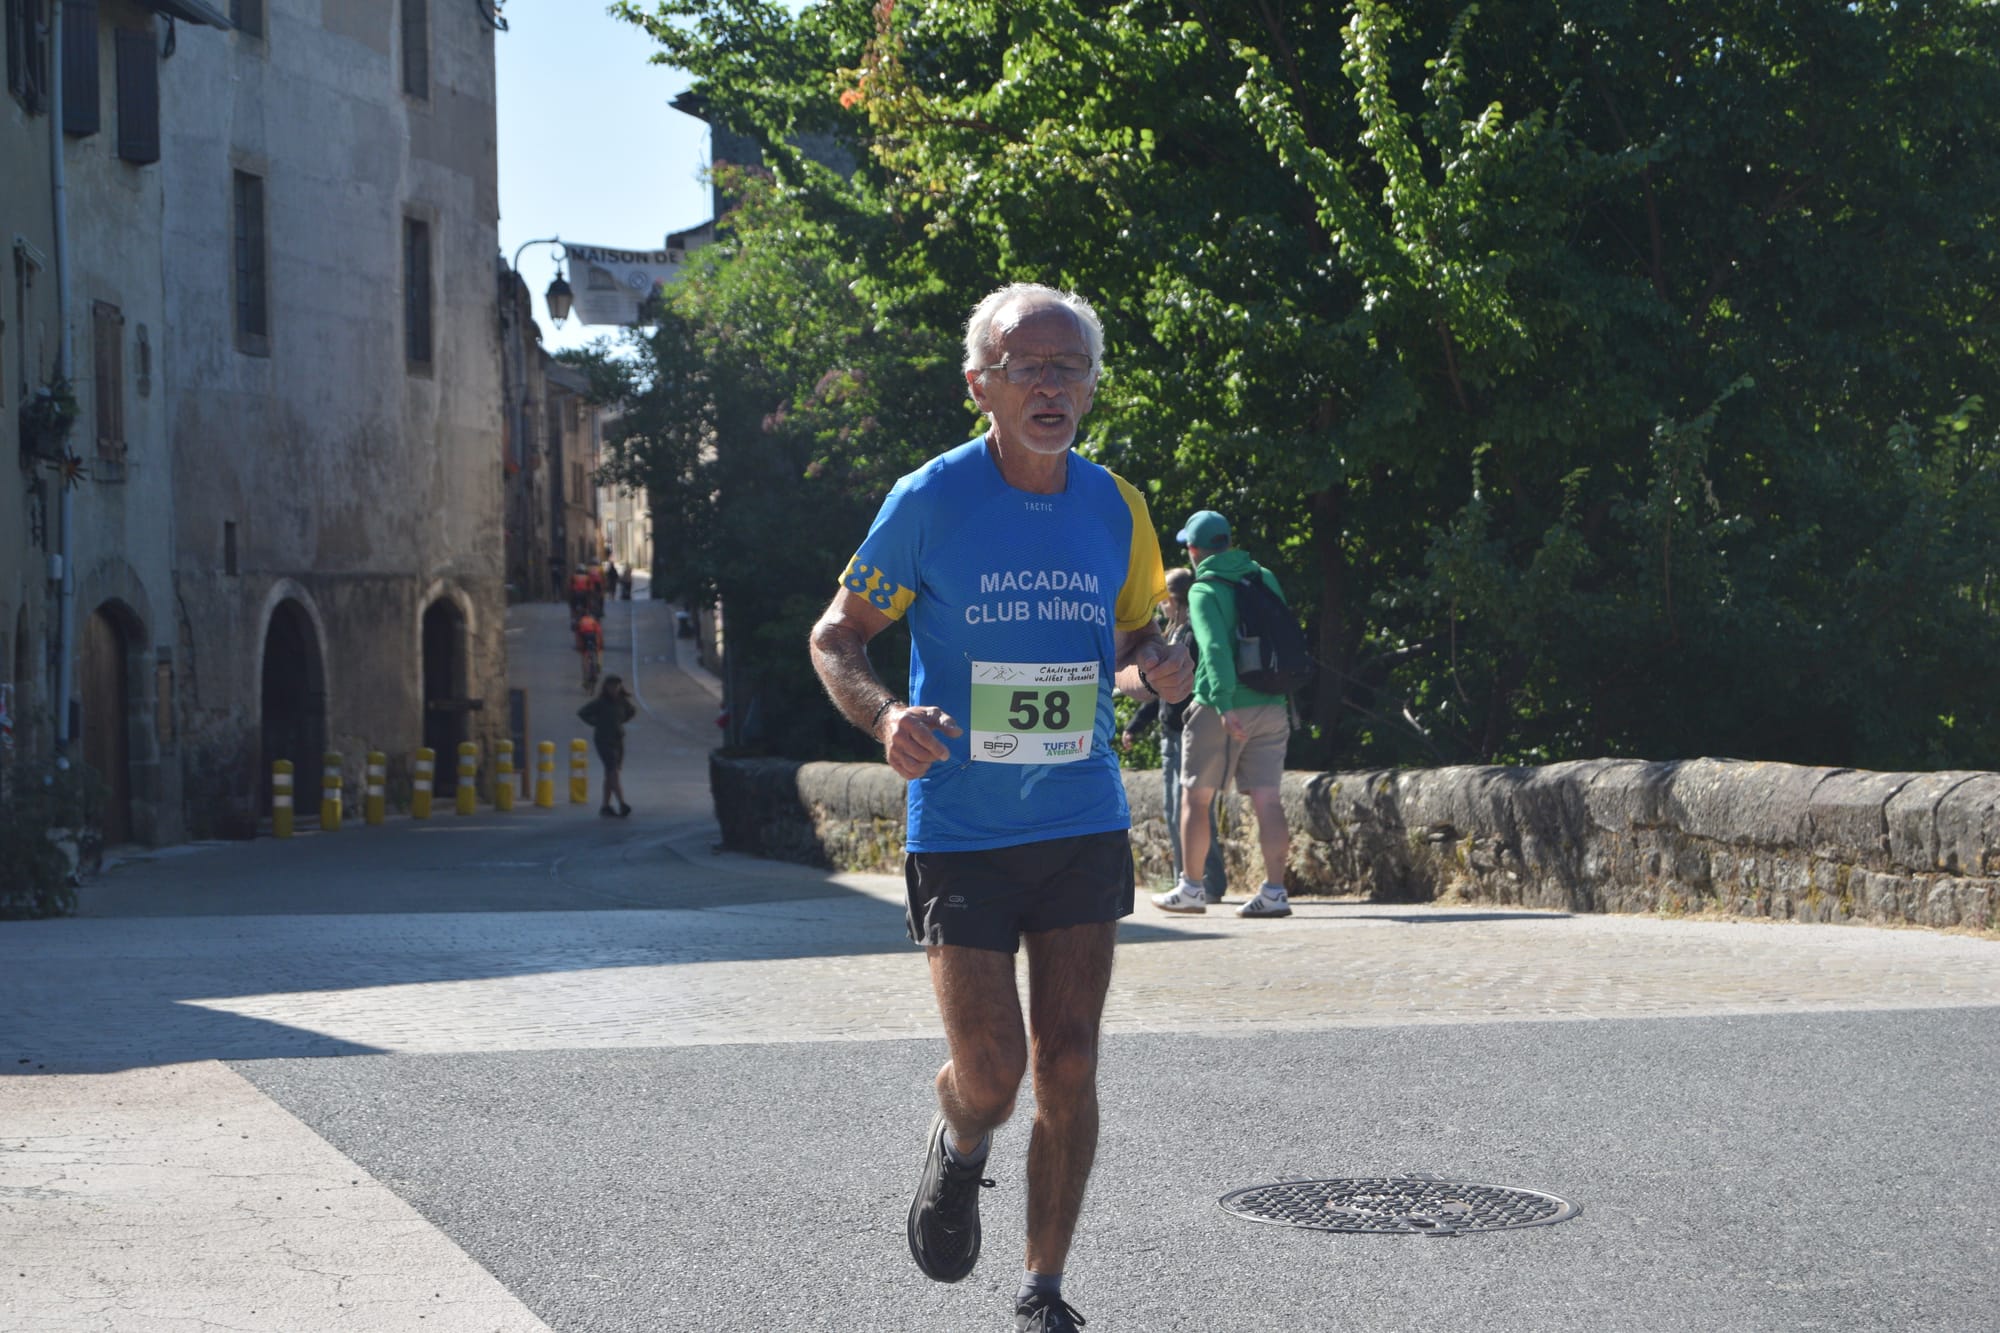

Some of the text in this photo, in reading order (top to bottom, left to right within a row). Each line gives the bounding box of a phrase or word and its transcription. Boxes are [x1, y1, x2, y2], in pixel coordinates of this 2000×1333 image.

[571, 247, 649, 264] MAISON
[1025, 502, 1052, 512] TACTIC
[981, 571, 1099, 594] MACADAM
[965, 596, 1107, 626] CLUB NÎMOIS
[1040, 666, 1078, 675] Challenge
[1008, 690, 1070, 730] 58
[983, 741, 1014, 750] BFP
